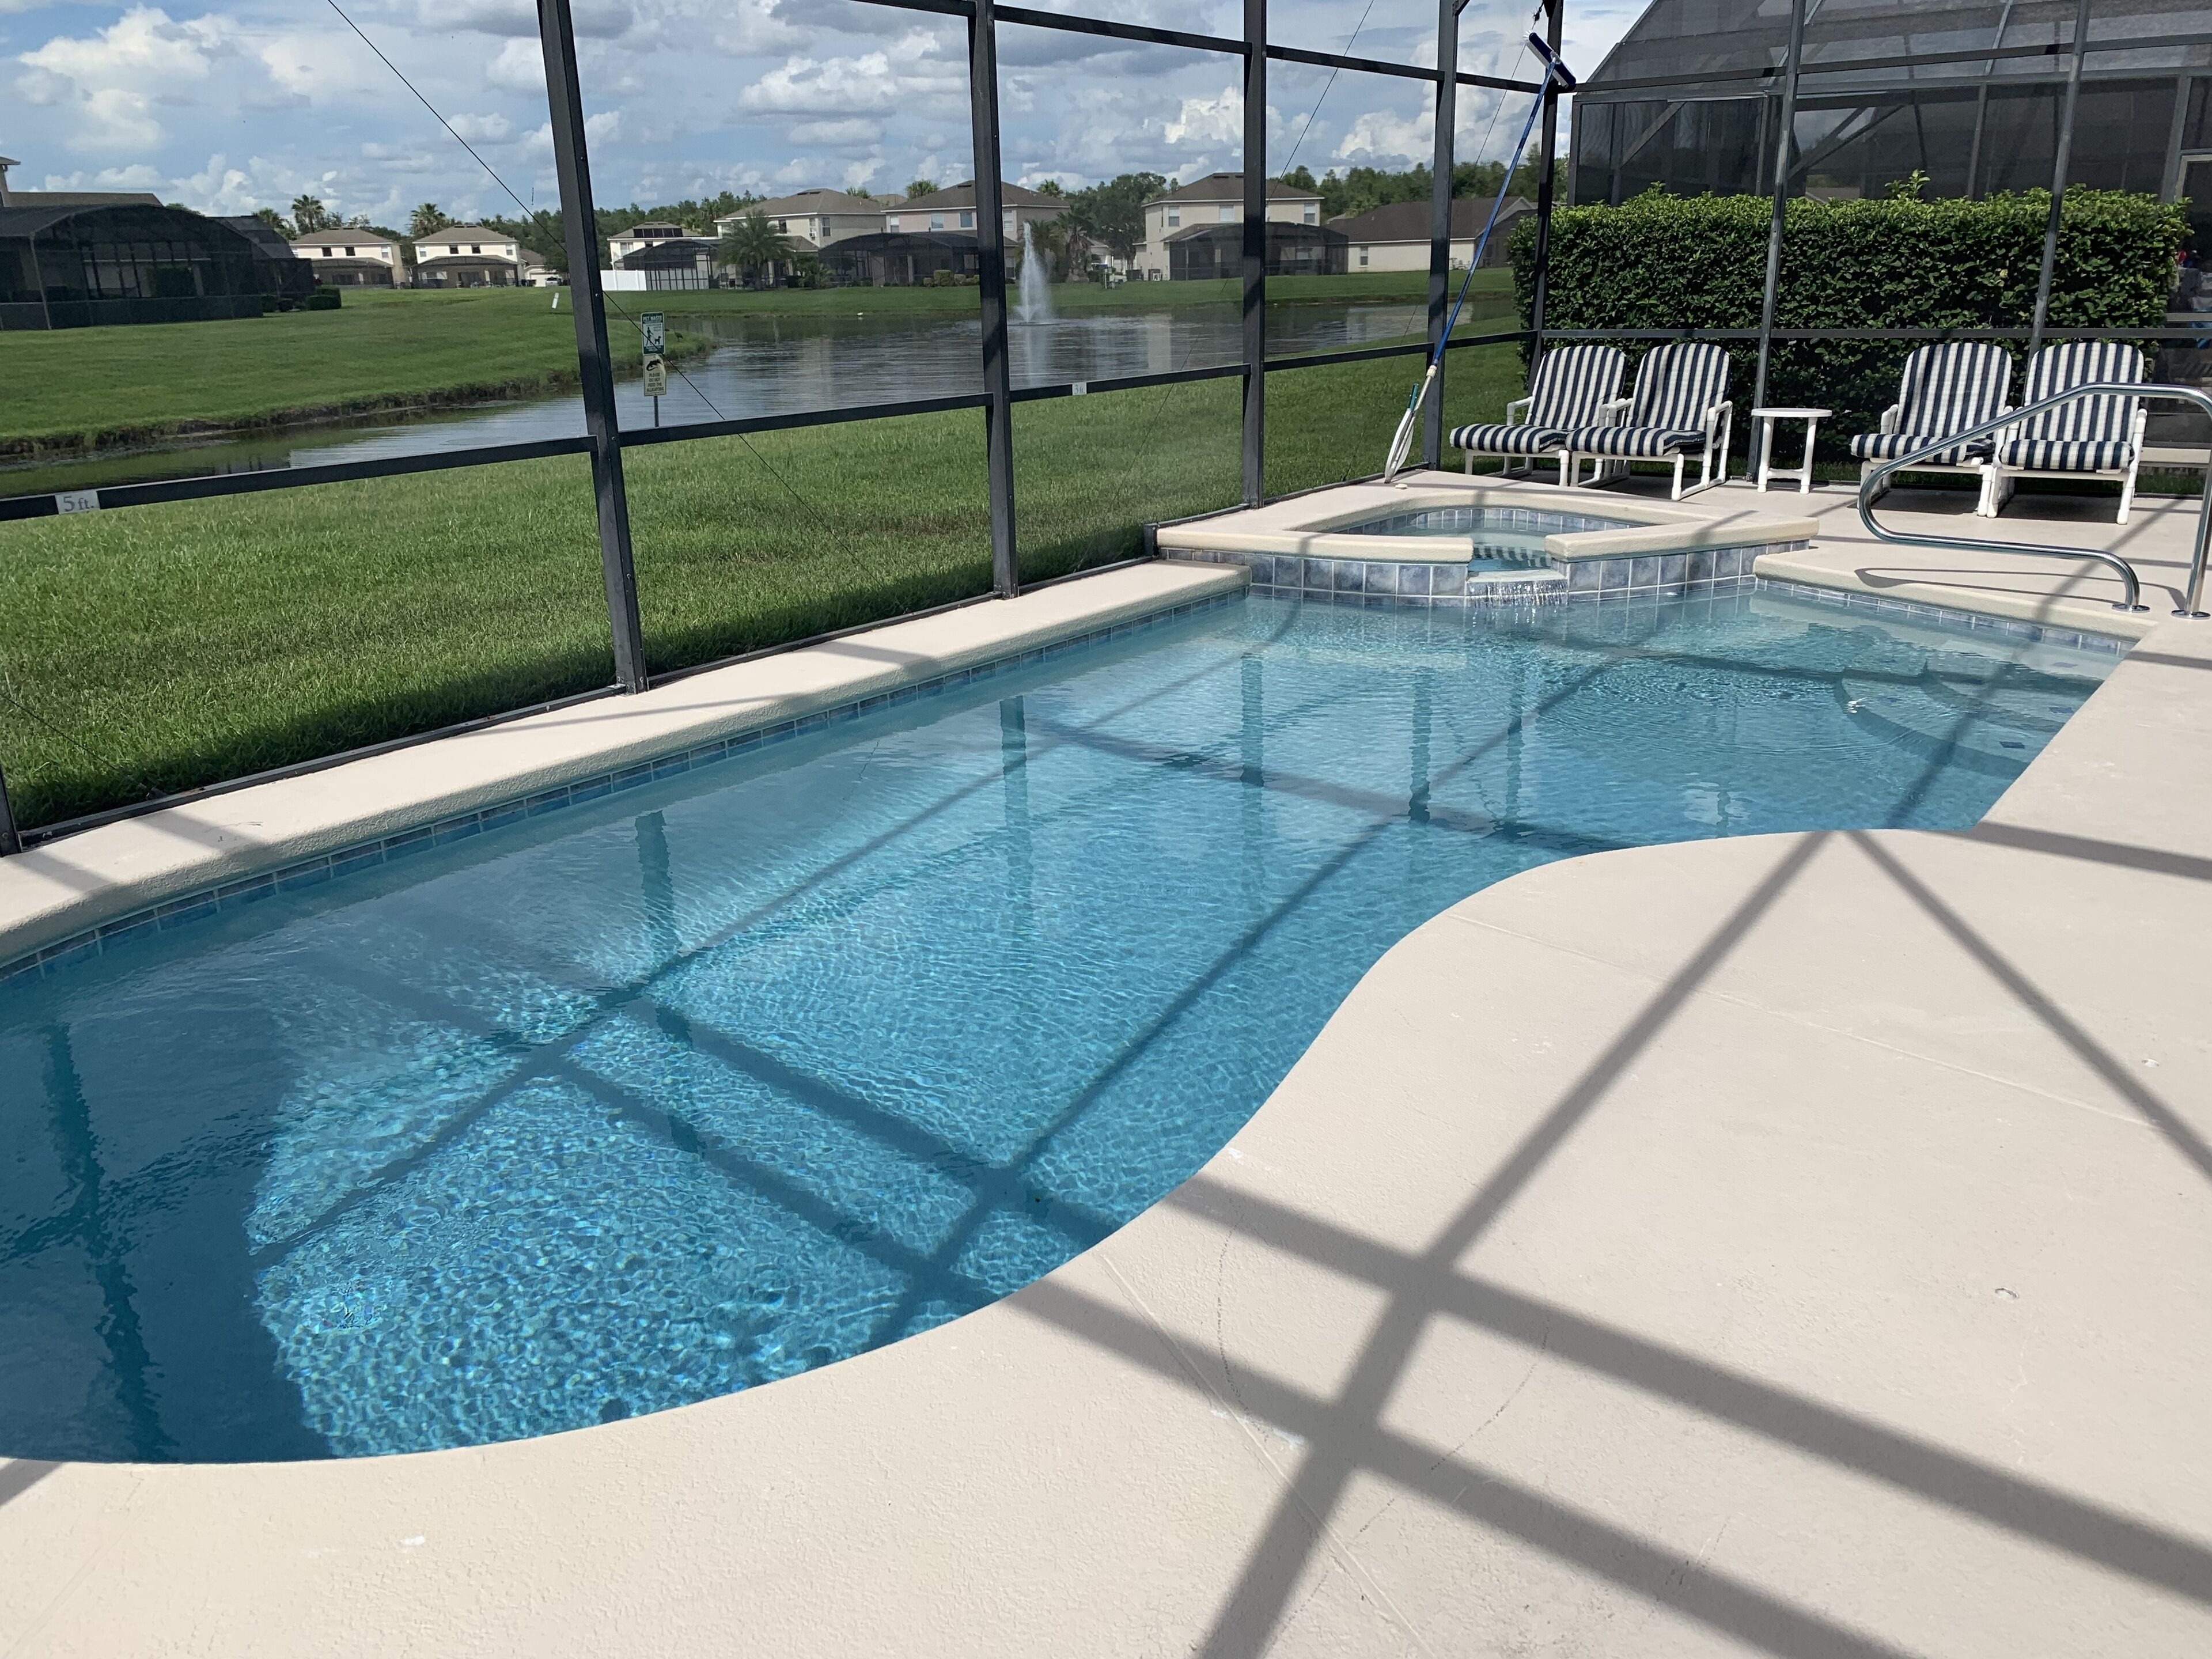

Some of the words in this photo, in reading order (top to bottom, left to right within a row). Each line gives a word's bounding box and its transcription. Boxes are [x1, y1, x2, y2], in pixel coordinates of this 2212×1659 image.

[1074, 384, 1079, 394] 3
[63, 495, 75, 512] 5
[78, 497, 94, 510] ft.
